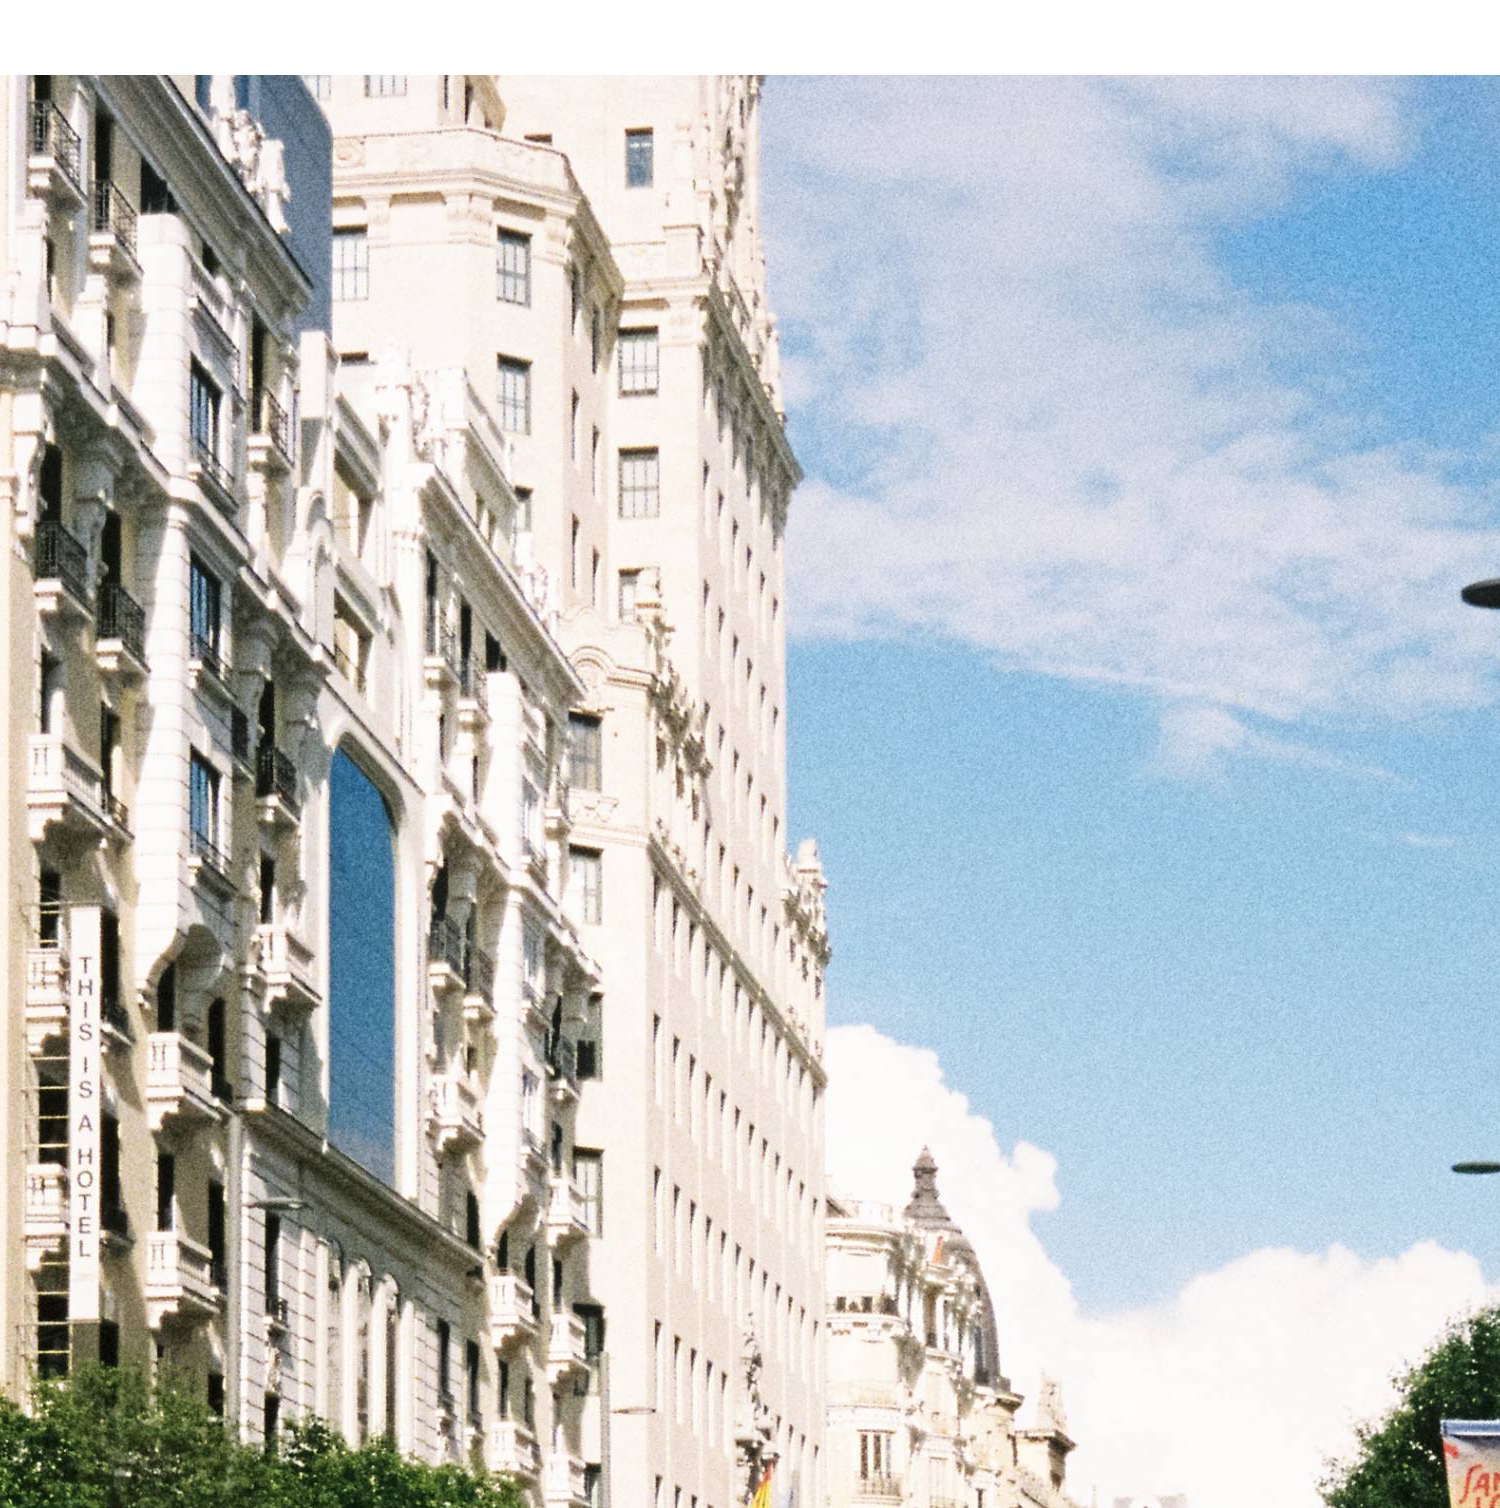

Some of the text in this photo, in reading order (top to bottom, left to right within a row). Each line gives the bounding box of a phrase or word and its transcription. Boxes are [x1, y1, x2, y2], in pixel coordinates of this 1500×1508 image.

[77, 956, 93, 1258] THIS IS A HOTEL
